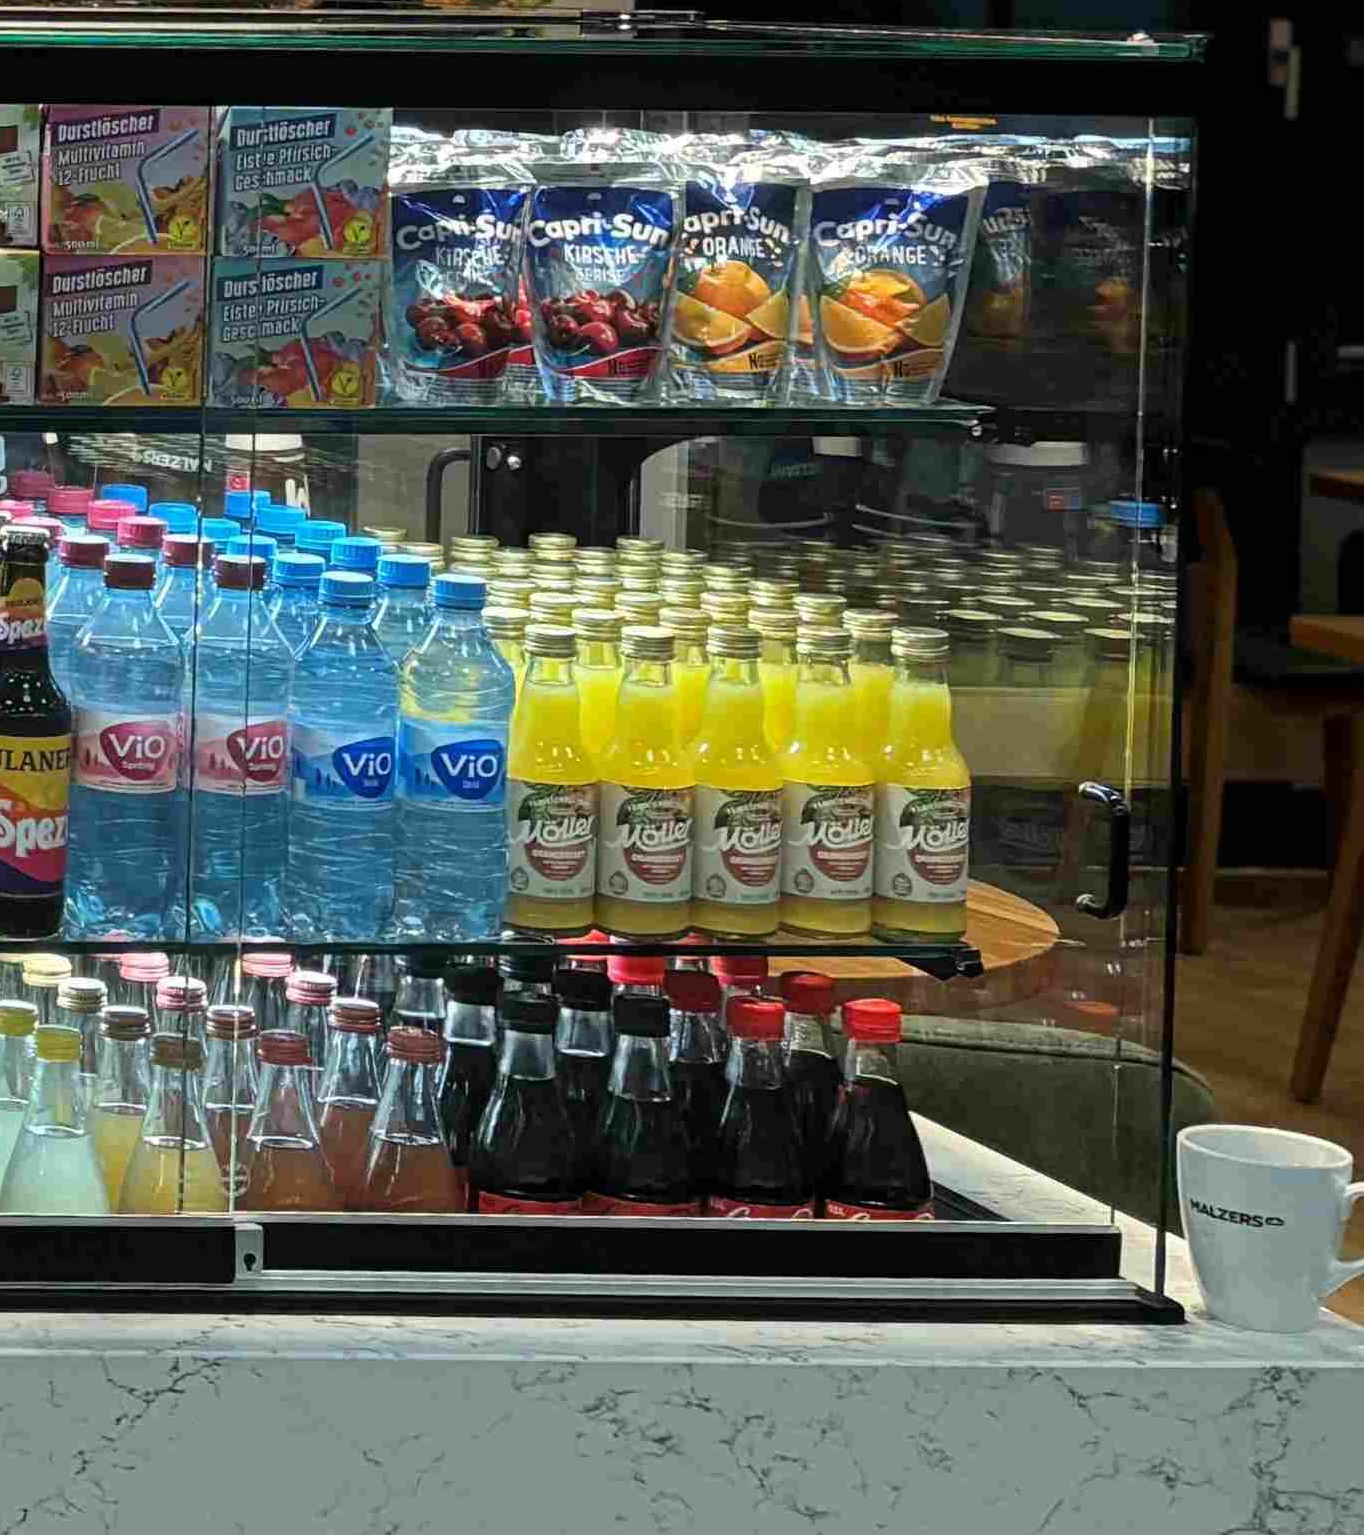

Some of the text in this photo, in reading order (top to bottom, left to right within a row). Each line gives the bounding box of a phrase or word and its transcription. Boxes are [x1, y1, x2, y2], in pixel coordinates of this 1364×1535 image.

[57, 115, 154, 141] Durstlöscher
[57, 142, 145, 165] Multivitamin
[702, 236, 766, 258] ORANGE
[854, 246, 927, 265] ORANGE
[52, 266, 147, 293] Durstlöscher
[1191, 1198, 1263, 1227] MALZERS
